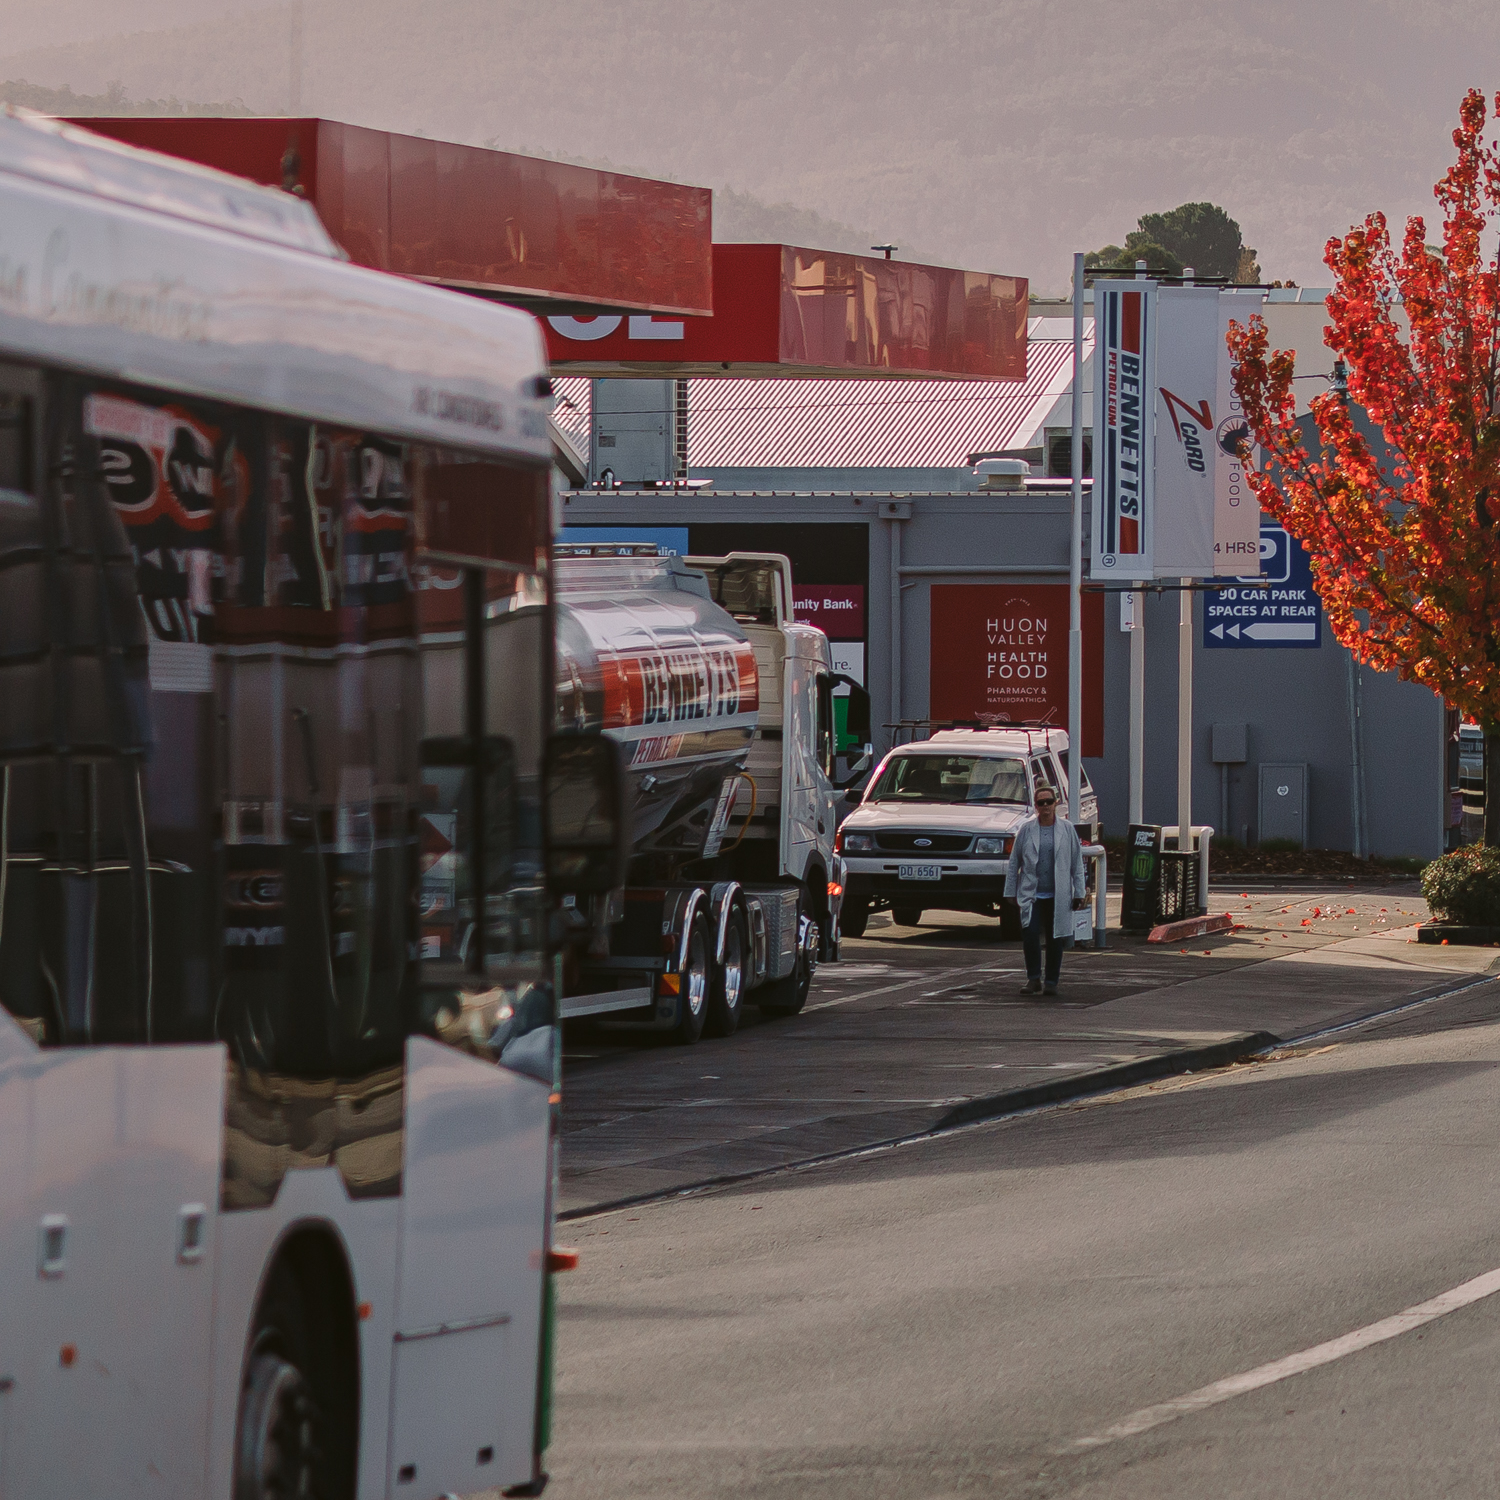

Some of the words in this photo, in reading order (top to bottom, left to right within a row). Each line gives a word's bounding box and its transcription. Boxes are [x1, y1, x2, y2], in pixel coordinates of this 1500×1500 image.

[1107, 351, 1117, 427] PETROLEUM
[1119, 353, 1141, 517] BENNETTS
[1179, 421, 1206, 472] CARD
[1229, 462, 1241, 509] FOOD
[1225, 541, 1257, 555] HRS
[1219, 588, 1237, 600] 90
[1241, 589, 1268, 600] CAR
[1271, 589, 1307, 600] PARK
[823, 598, 854, 610] Bank
[1208, 605, 1258, 617] SPACES
[1260, 605, 1278, 617] AT
[1280, 605, 1316, 617] REAR
[986, 617, 1048, 632] HUON
[987, 634, 1047, 645] VALLEY
[987, 651, 1048, 663] HEALTH
[987, 664, 1048, 679] FOOD
[638, 650, 741, 725] BENNETTS
[986, 686, 1039, 695] PHARMACY
[1040, 686, 1047, 695] &
[917, 866, 939, 877] 6561
